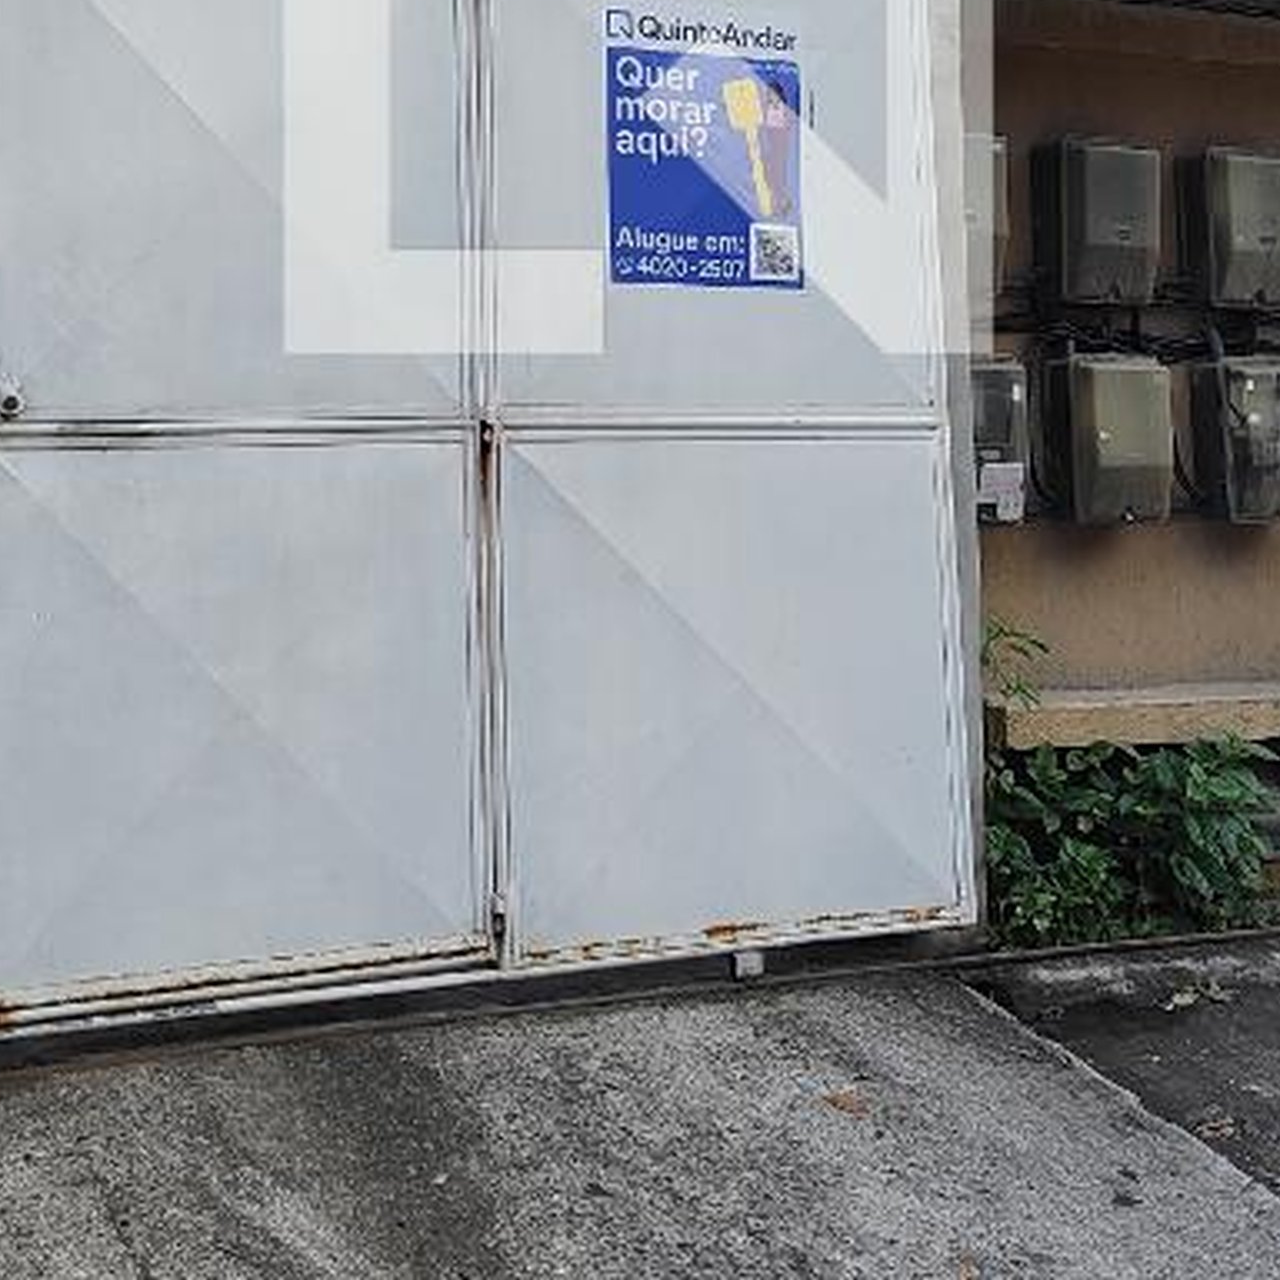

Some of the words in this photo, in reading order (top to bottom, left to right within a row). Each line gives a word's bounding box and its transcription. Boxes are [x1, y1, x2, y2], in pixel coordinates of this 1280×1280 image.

[638, 15, 796, 51] QuintoAndar
[616, 56, 699, 90] Quer
[616, 95, 717, 124] morar
[616, 127, 708, 164] aqui?
[616, 226, 698, 254] Alugue
[704, 233, 745, 254] em:
